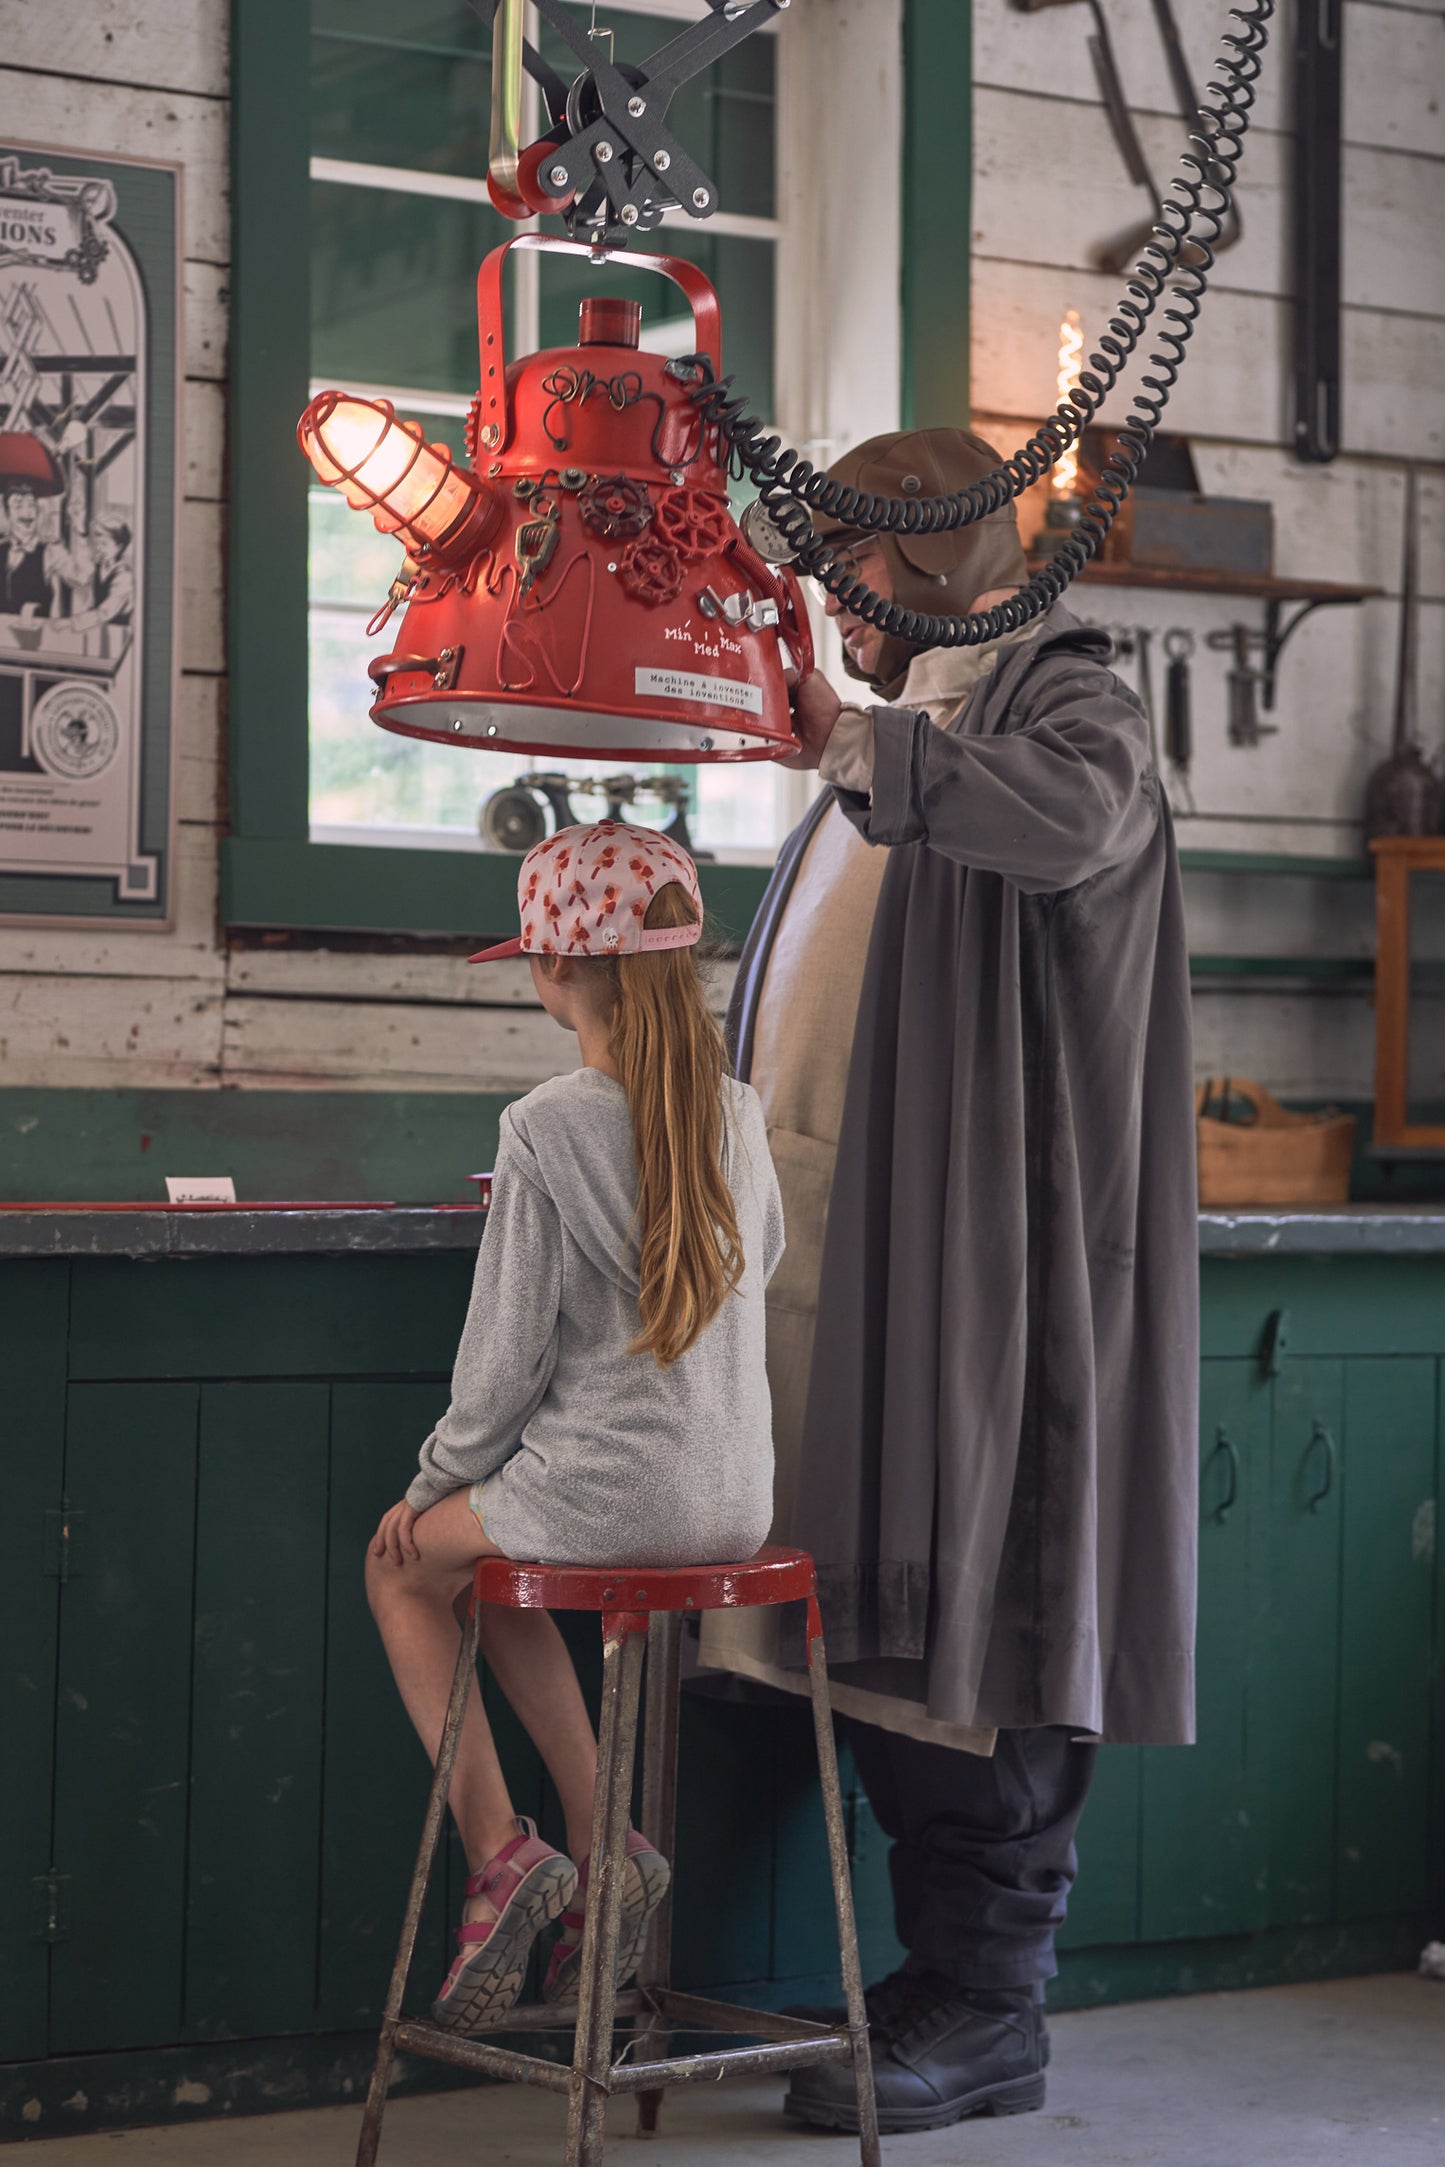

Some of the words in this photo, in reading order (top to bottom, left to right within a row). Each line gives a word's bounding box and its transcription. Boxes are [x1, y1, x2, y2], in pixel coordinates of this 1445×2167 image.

[664, 627, 692, 642] Min
[694, 642, 720, 658] Med
[719, 636, 742, 654] Max
[650, 674, 695, 687] Machine
[664, 685, 683, 695] des
[690, 688, 745, 706] inventions
